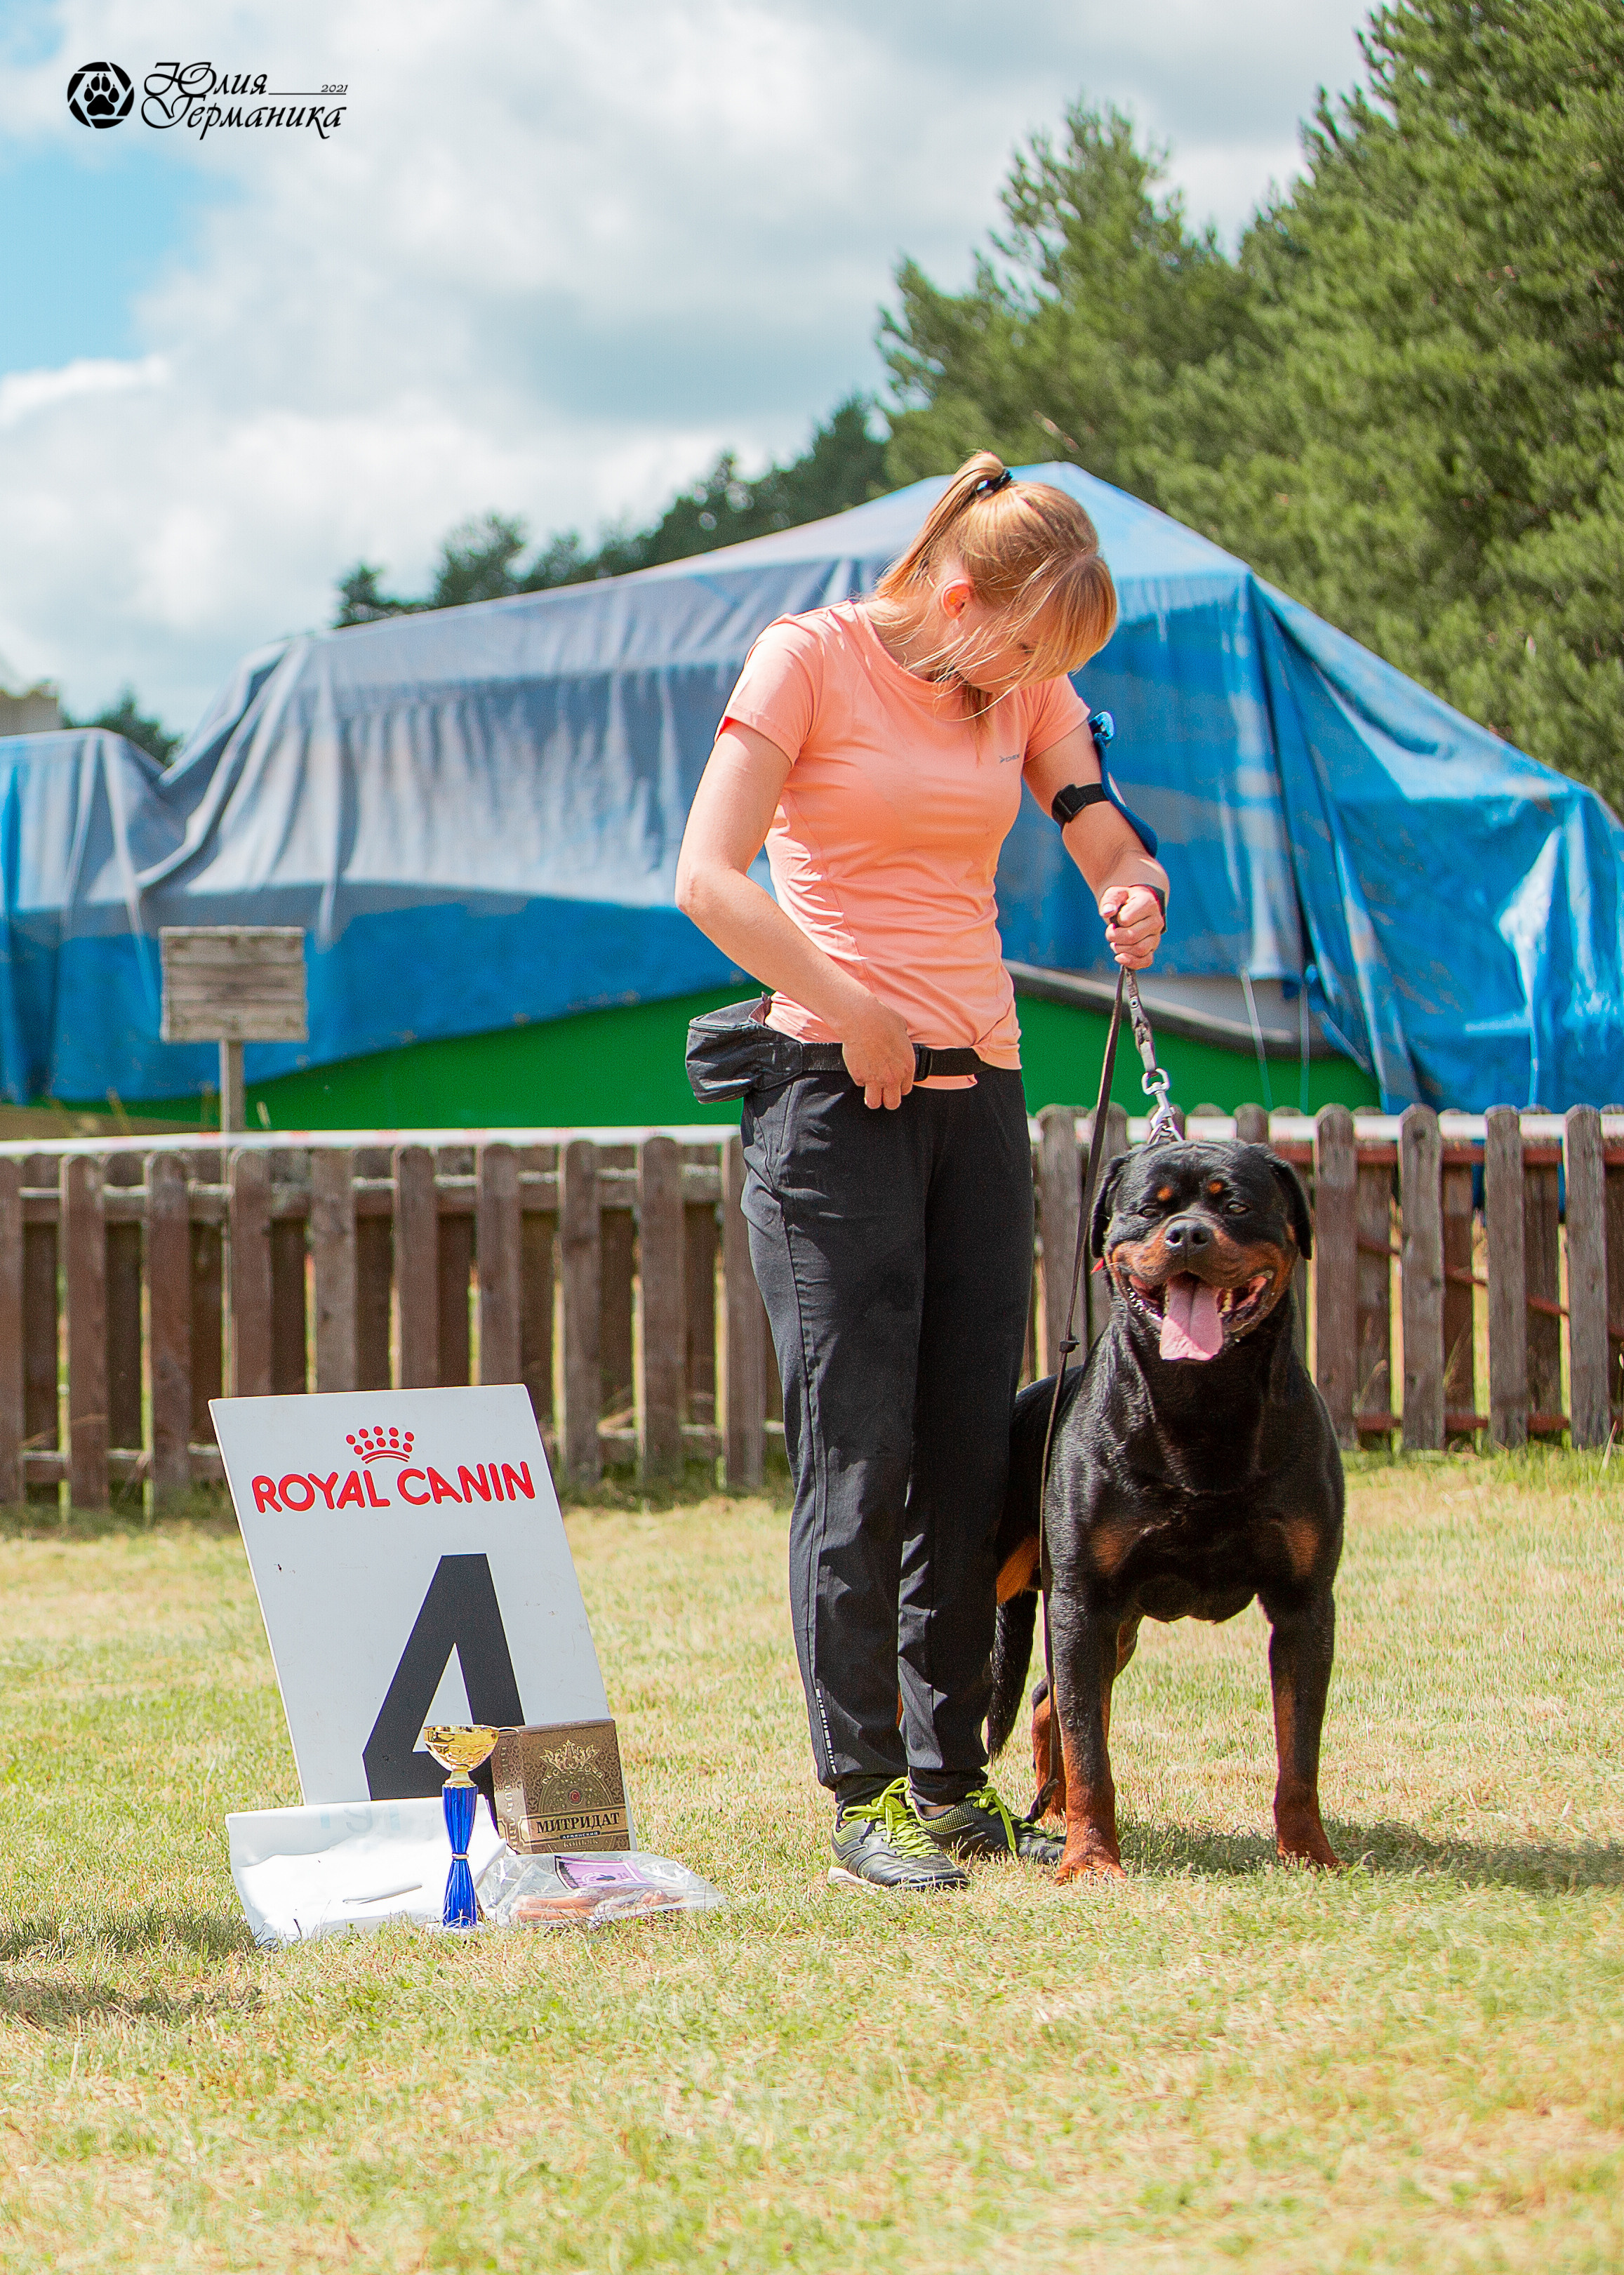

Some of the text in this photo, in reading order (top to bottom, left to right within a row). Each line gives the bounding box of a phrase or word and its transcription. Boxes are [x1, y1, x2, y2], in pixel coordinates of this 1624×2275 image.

[251, 1460, 535, 1513] ROYAL CANIN
[361, 1552, 525, 1825] 4
[536, 1812, 620, 1833] МИТРИДАТ
